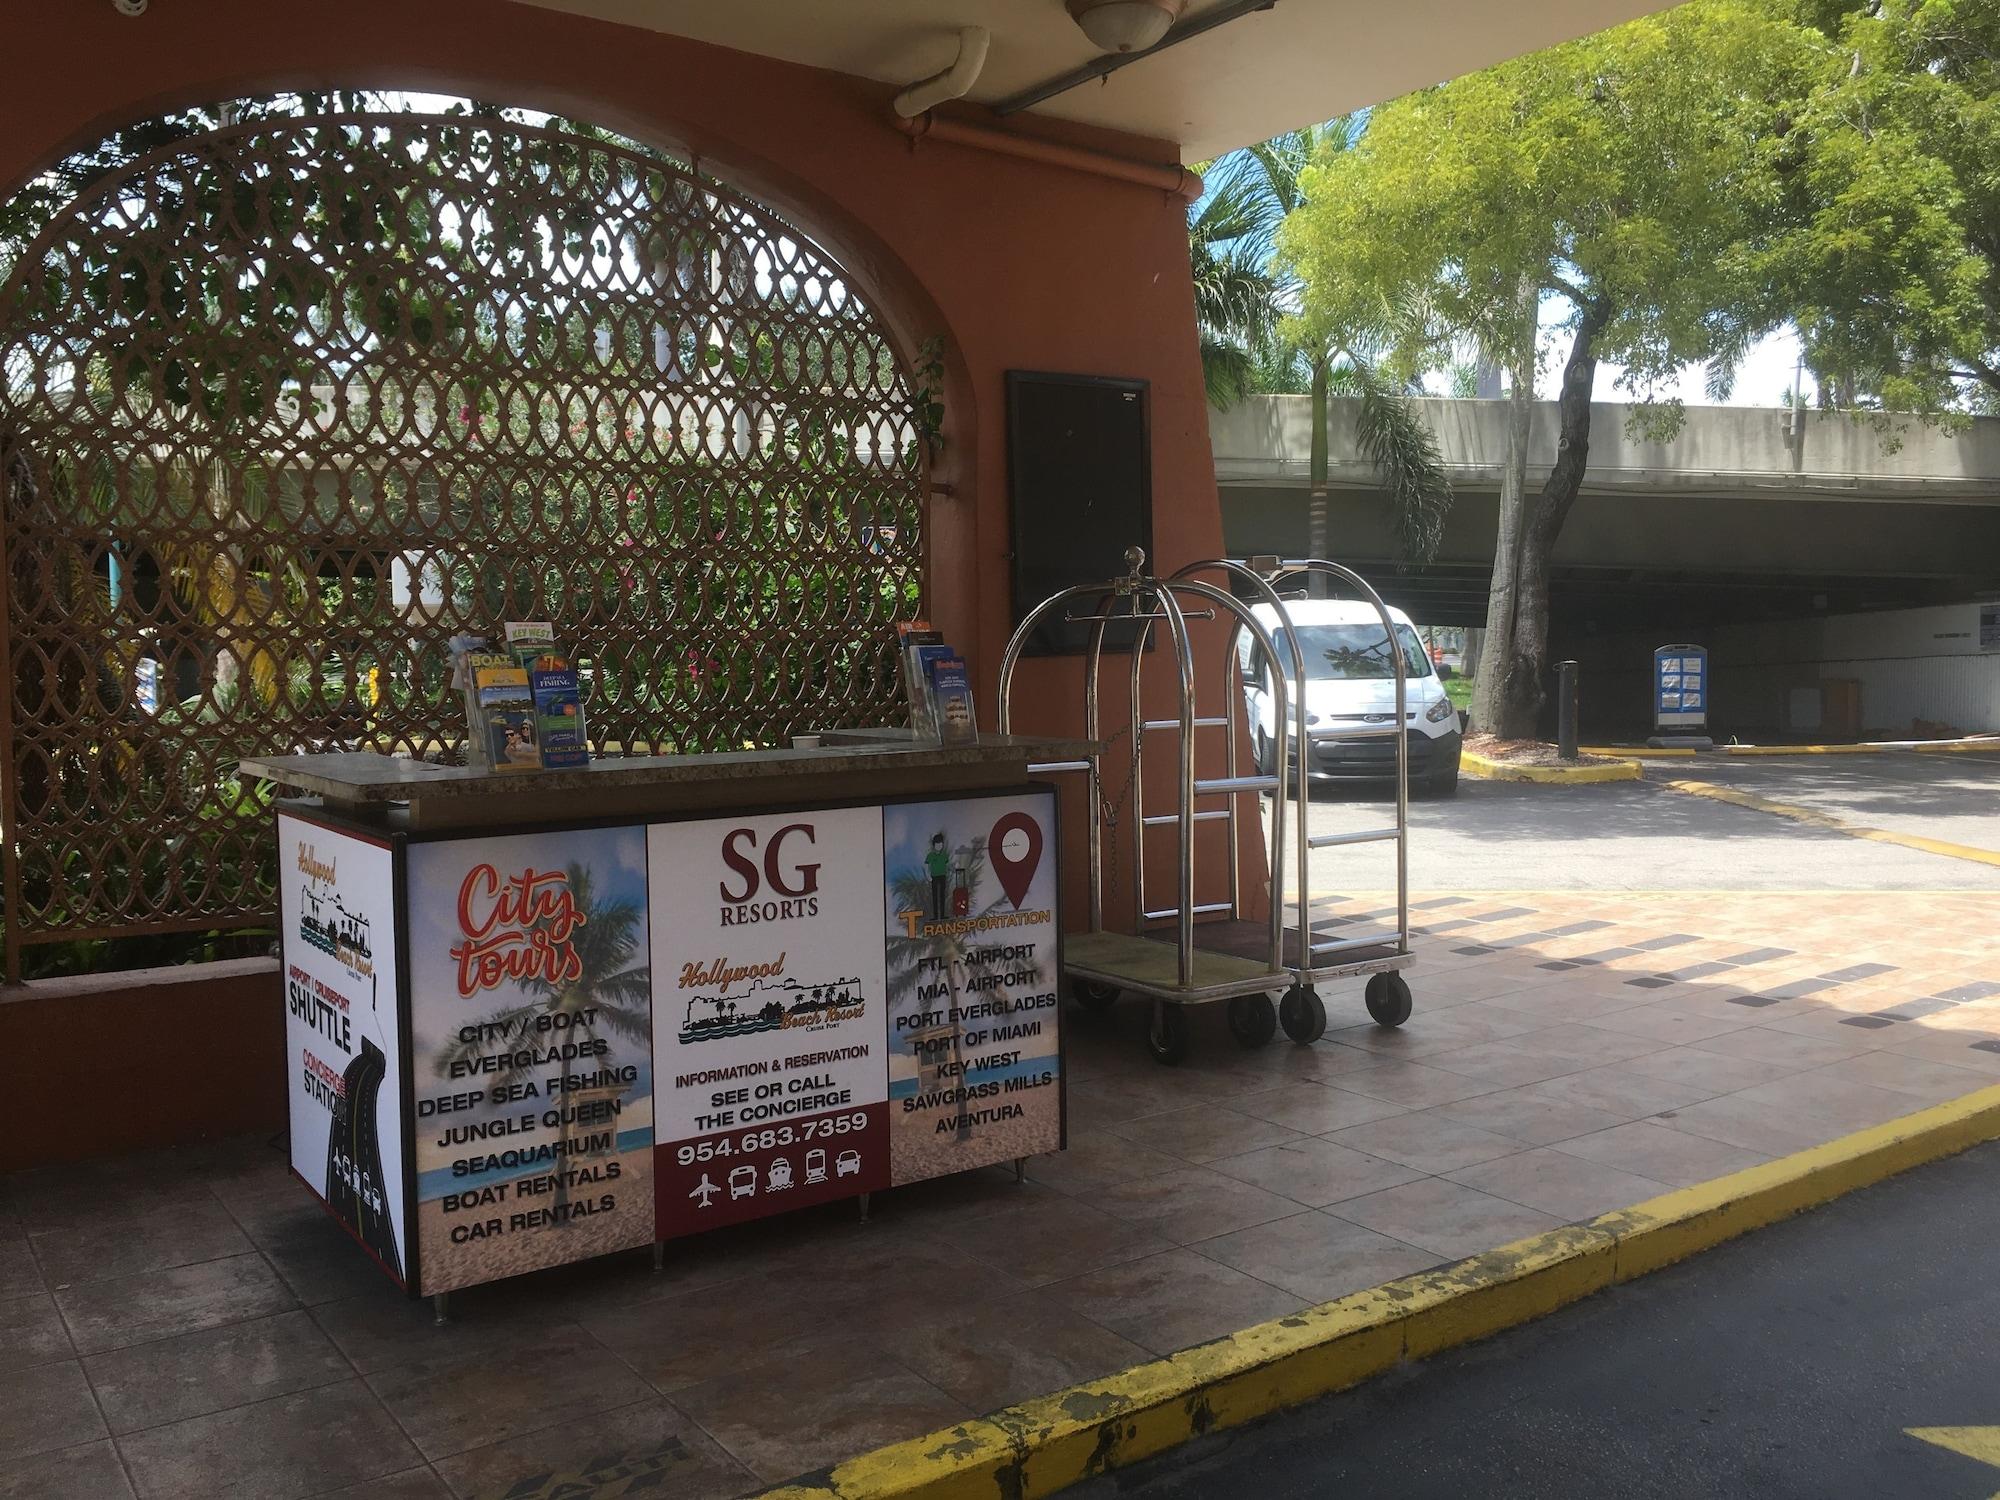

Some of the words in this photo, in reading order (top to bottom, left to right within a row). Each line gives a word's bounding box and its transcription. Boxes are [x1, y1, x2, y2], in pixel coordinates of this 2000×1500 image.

[512, 628, 526, 638] KEY
[528, 627, 550, 638] WEST
[470, 655, 510, 667] BOAT
[540, 679, 570, 687] FISHING
[298, 840, 336, 889] Hollywood
[720, 823, 821, 904] SG
[457, 863, 587, 944] City
[720, 897, 819, 927] RESORTS
[289, 963, 311, 990] AIRPORT
[449, 927, 583, 999] tours
[678, 951, 786, 993] Hollywood
[918, 956, 949, 973] FTL
[964, 944, 1036, 967] AIRPORT
[917, 982, 949, 1001] MIA
[965, 969, 1037, 994] AIRPORT
[289, 980, 352, 1055] SHUTTLE
[459, 1020, 516, 1044] CITY
[520, 1017, 529, 1036] /
[536, 1008, 599, 1033] BOAT
[779, 1010, 822, 1030] Beach
[825, 1000, 866, 1023] Resort
[896, 1010, 944, 1032] PORT
[948, 992, 1057, 1023] EVERGLADES
[450, 1038, 608, 1079] EVERGLADES
[914, 1034, 961, 1055] PORT
[965, 1030, 988, 1047] OF
[992, 1021, 1041, 1043] MIAMI
[303, 1048, 346, 1099] CONCIERGE
[675, 1061, 768, 1089] INFORMATION
[771, 1058, 781, 1073] &
[784, 1044, 870, 1070] RESERVATION
[937, 1059, 971, 1079] KEY
[974, 1050, 1021, 1072] WEST
[418, 1090, 484, 1117] DEEP
[491, 1081, 540, 1105] SEA
[546, 1065, 638, 1096] FISHING
[694, 1110, 735, 1131] THE
[740, 1088, 852, 1123] CONCIERGE
[711, 1087, 750, 1108] SEE
[754, 1082, 783, 1100] OR
[788, 1073, 836, 1094] CALL
[903, 1081, 1000, 1113] SAWGRASS
[1004, 1071, 1053, 1093] MILLS
[437, 1114, 535, 1147] JUNGLE
[542, 1098, 622, 1128] QUEEN
[677, 1111, 868, 1166] 954.683.7359
[935, 1103, 1024, 1134] AVENTURA
[452, 1132, 611, 1178] SEAQUARIUM
[442, 1184, 509, 1213] BOAT
[517, 1162, 621, 1198] RENTALS
[450, 1218, 503, 1244] CAR
[510, 1194, 616, 1232] RENTALS
